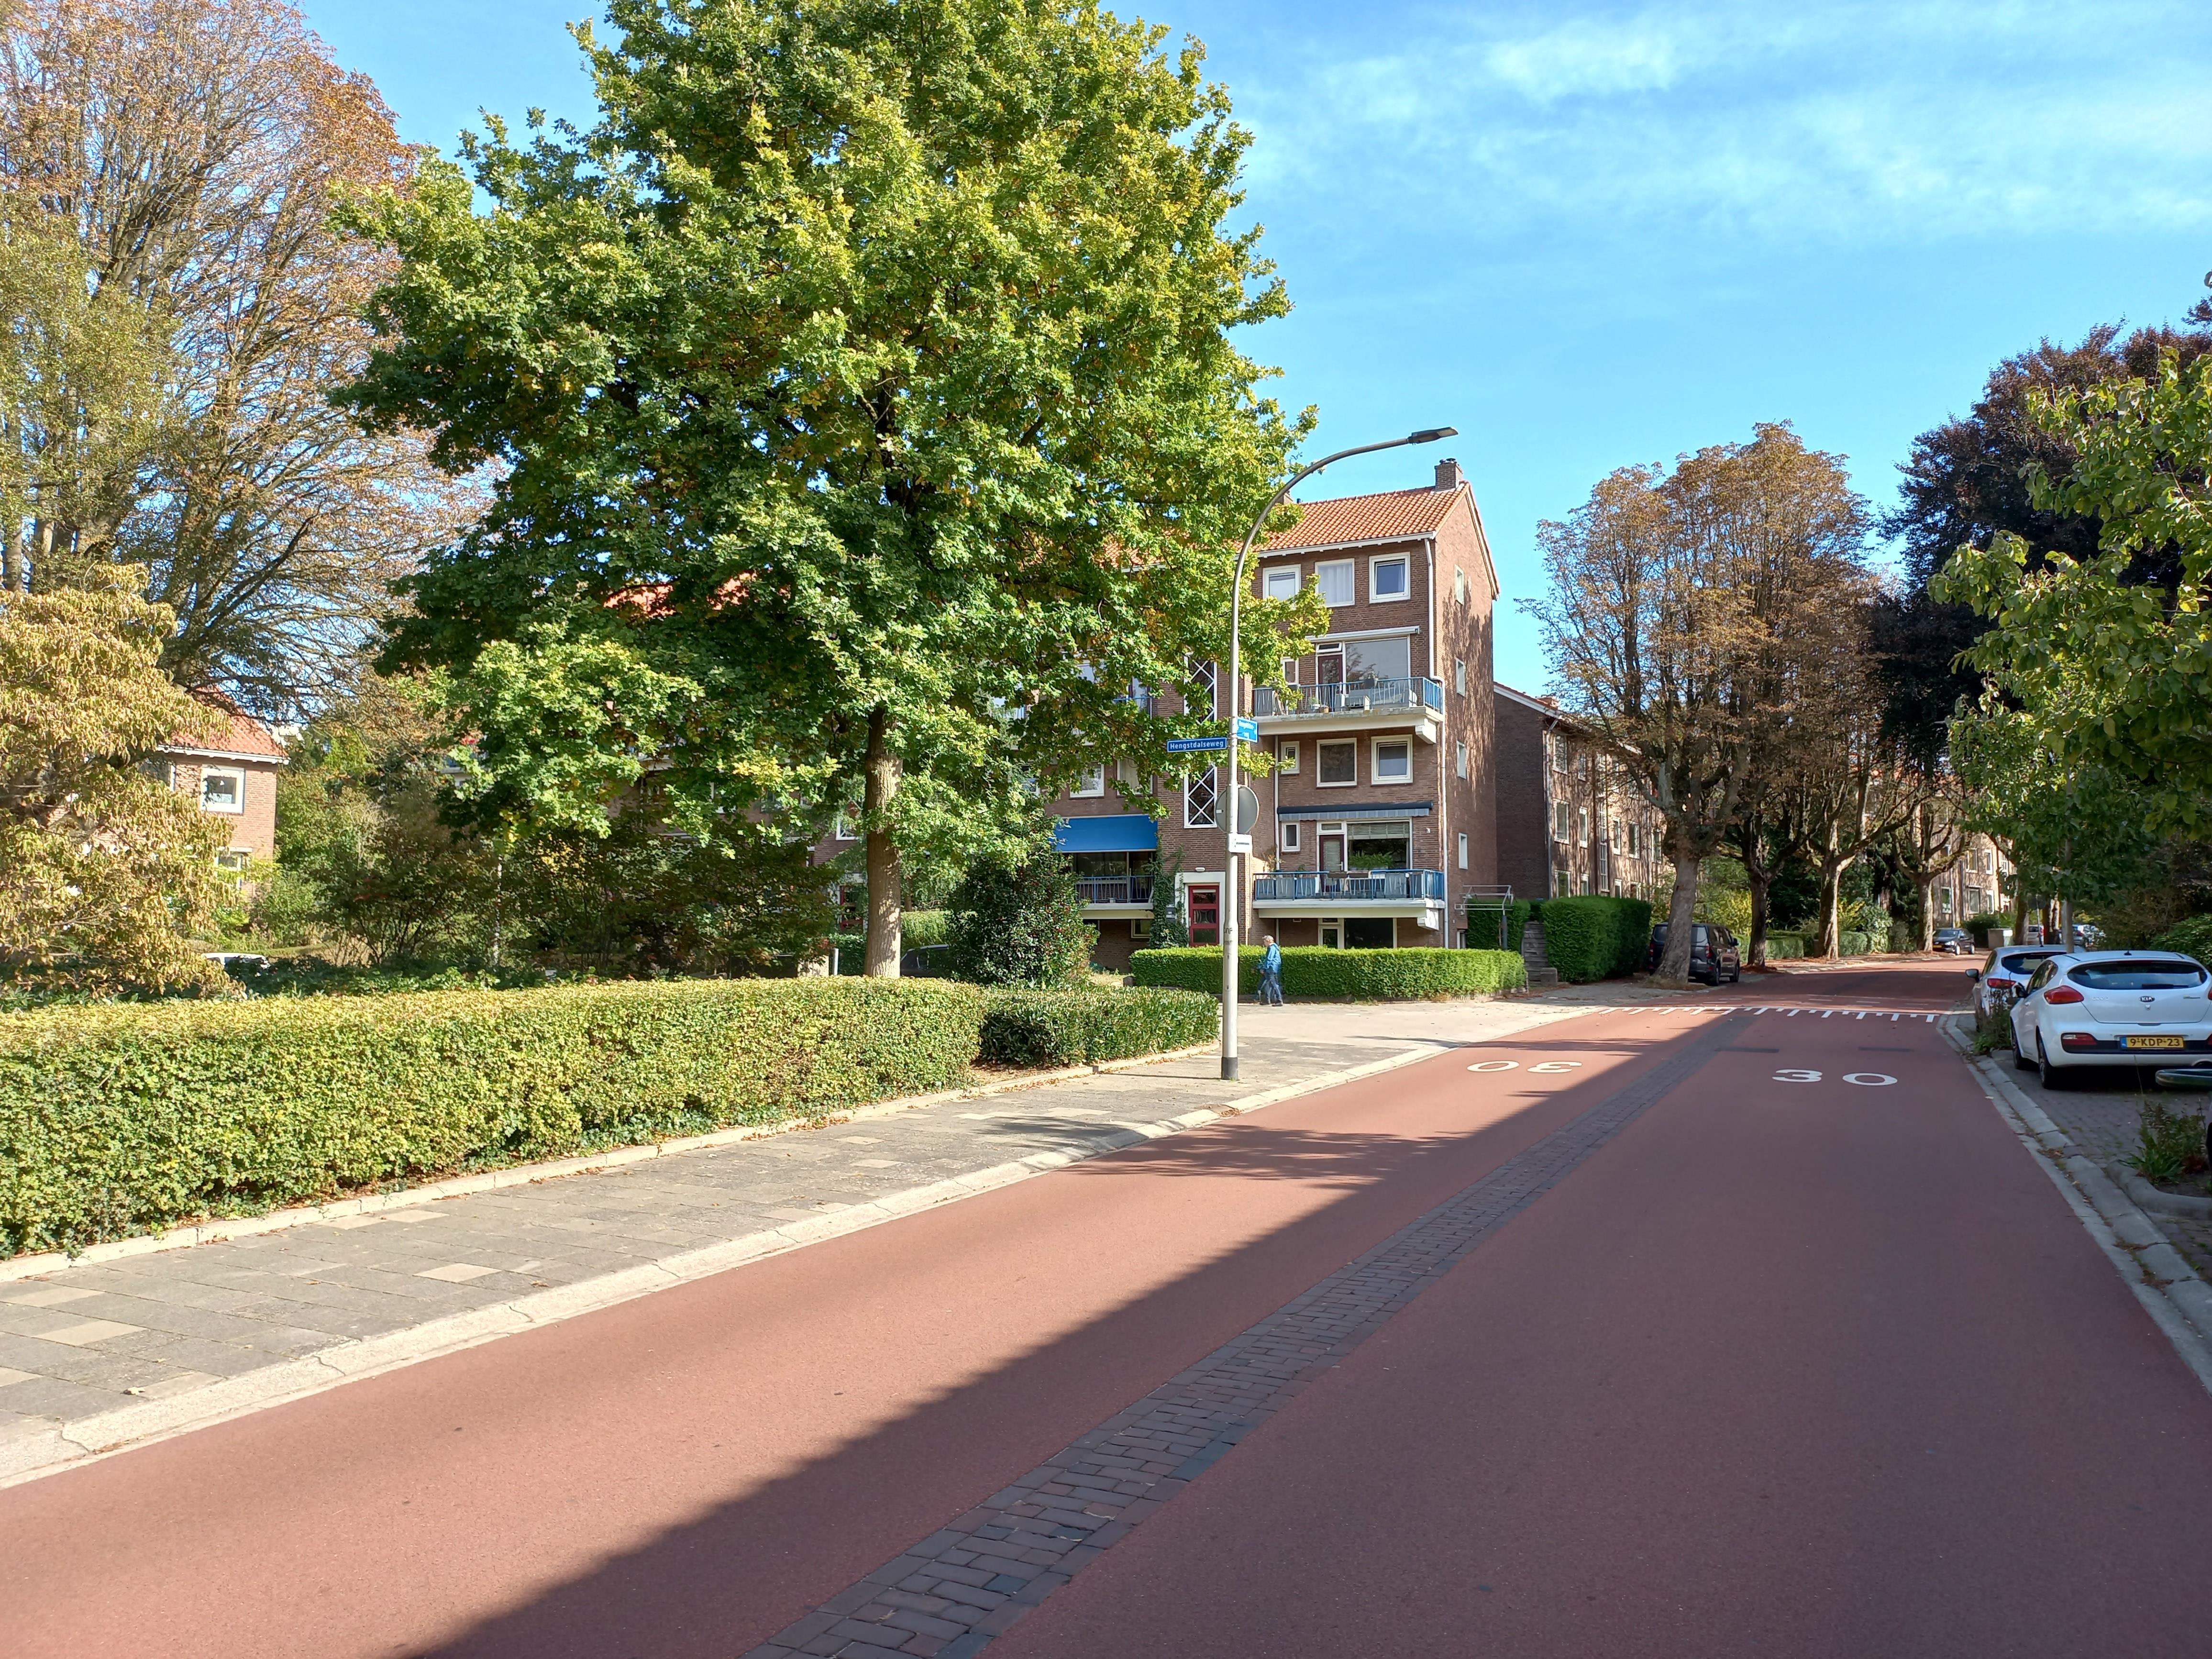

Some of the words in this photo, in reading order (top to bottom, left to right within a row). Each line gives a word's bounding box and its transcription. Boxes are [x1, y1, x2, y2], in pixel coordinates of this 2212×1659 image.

[1170, 741, 1224, 750] Hengstdalseweg
[2130, 1038, 2180, 1046] 9-KDP-23
[1772, 1069, 1898, 1086] 30
